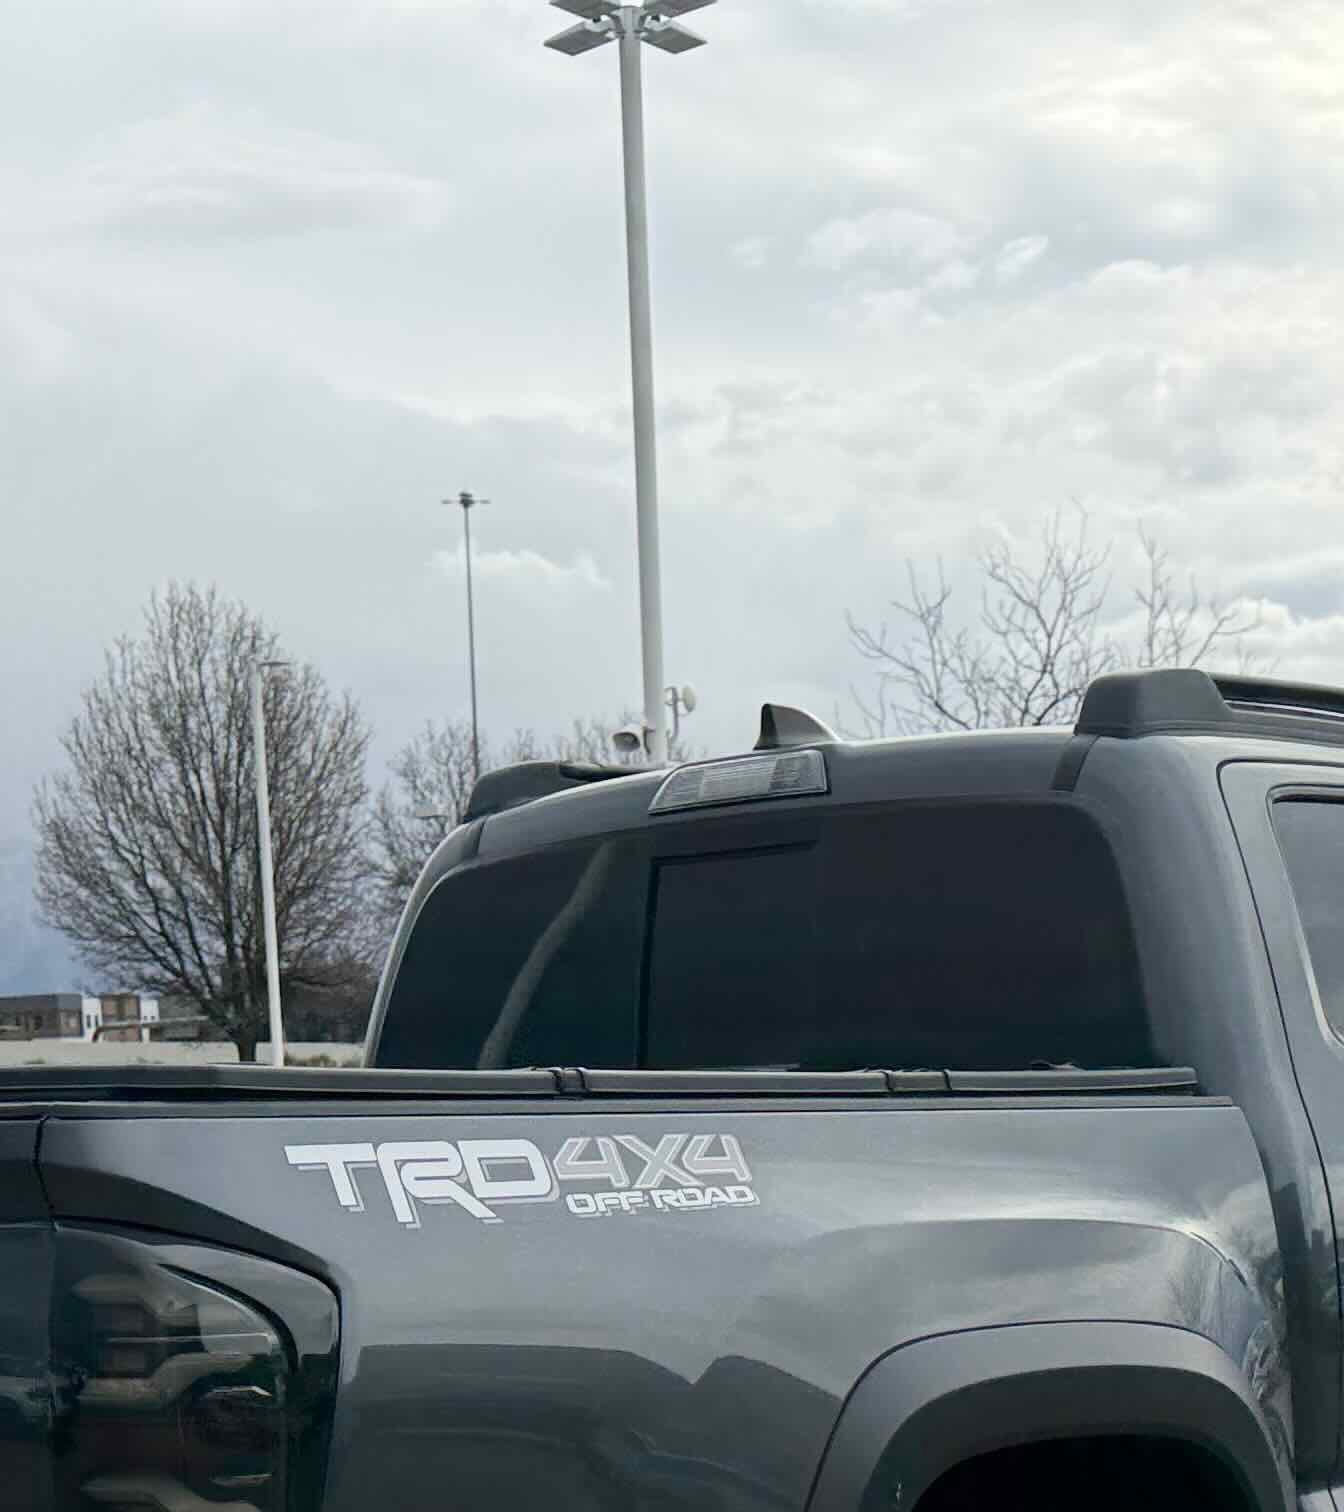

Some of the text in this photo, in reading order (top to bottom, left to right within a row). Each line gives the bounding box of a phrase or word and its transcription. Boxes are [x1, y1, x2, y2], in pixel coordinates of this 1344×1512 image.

[284, 1134, 752, 1230] TRD 4X4
[566, 1185, 760, 1217] OFF ROAD
